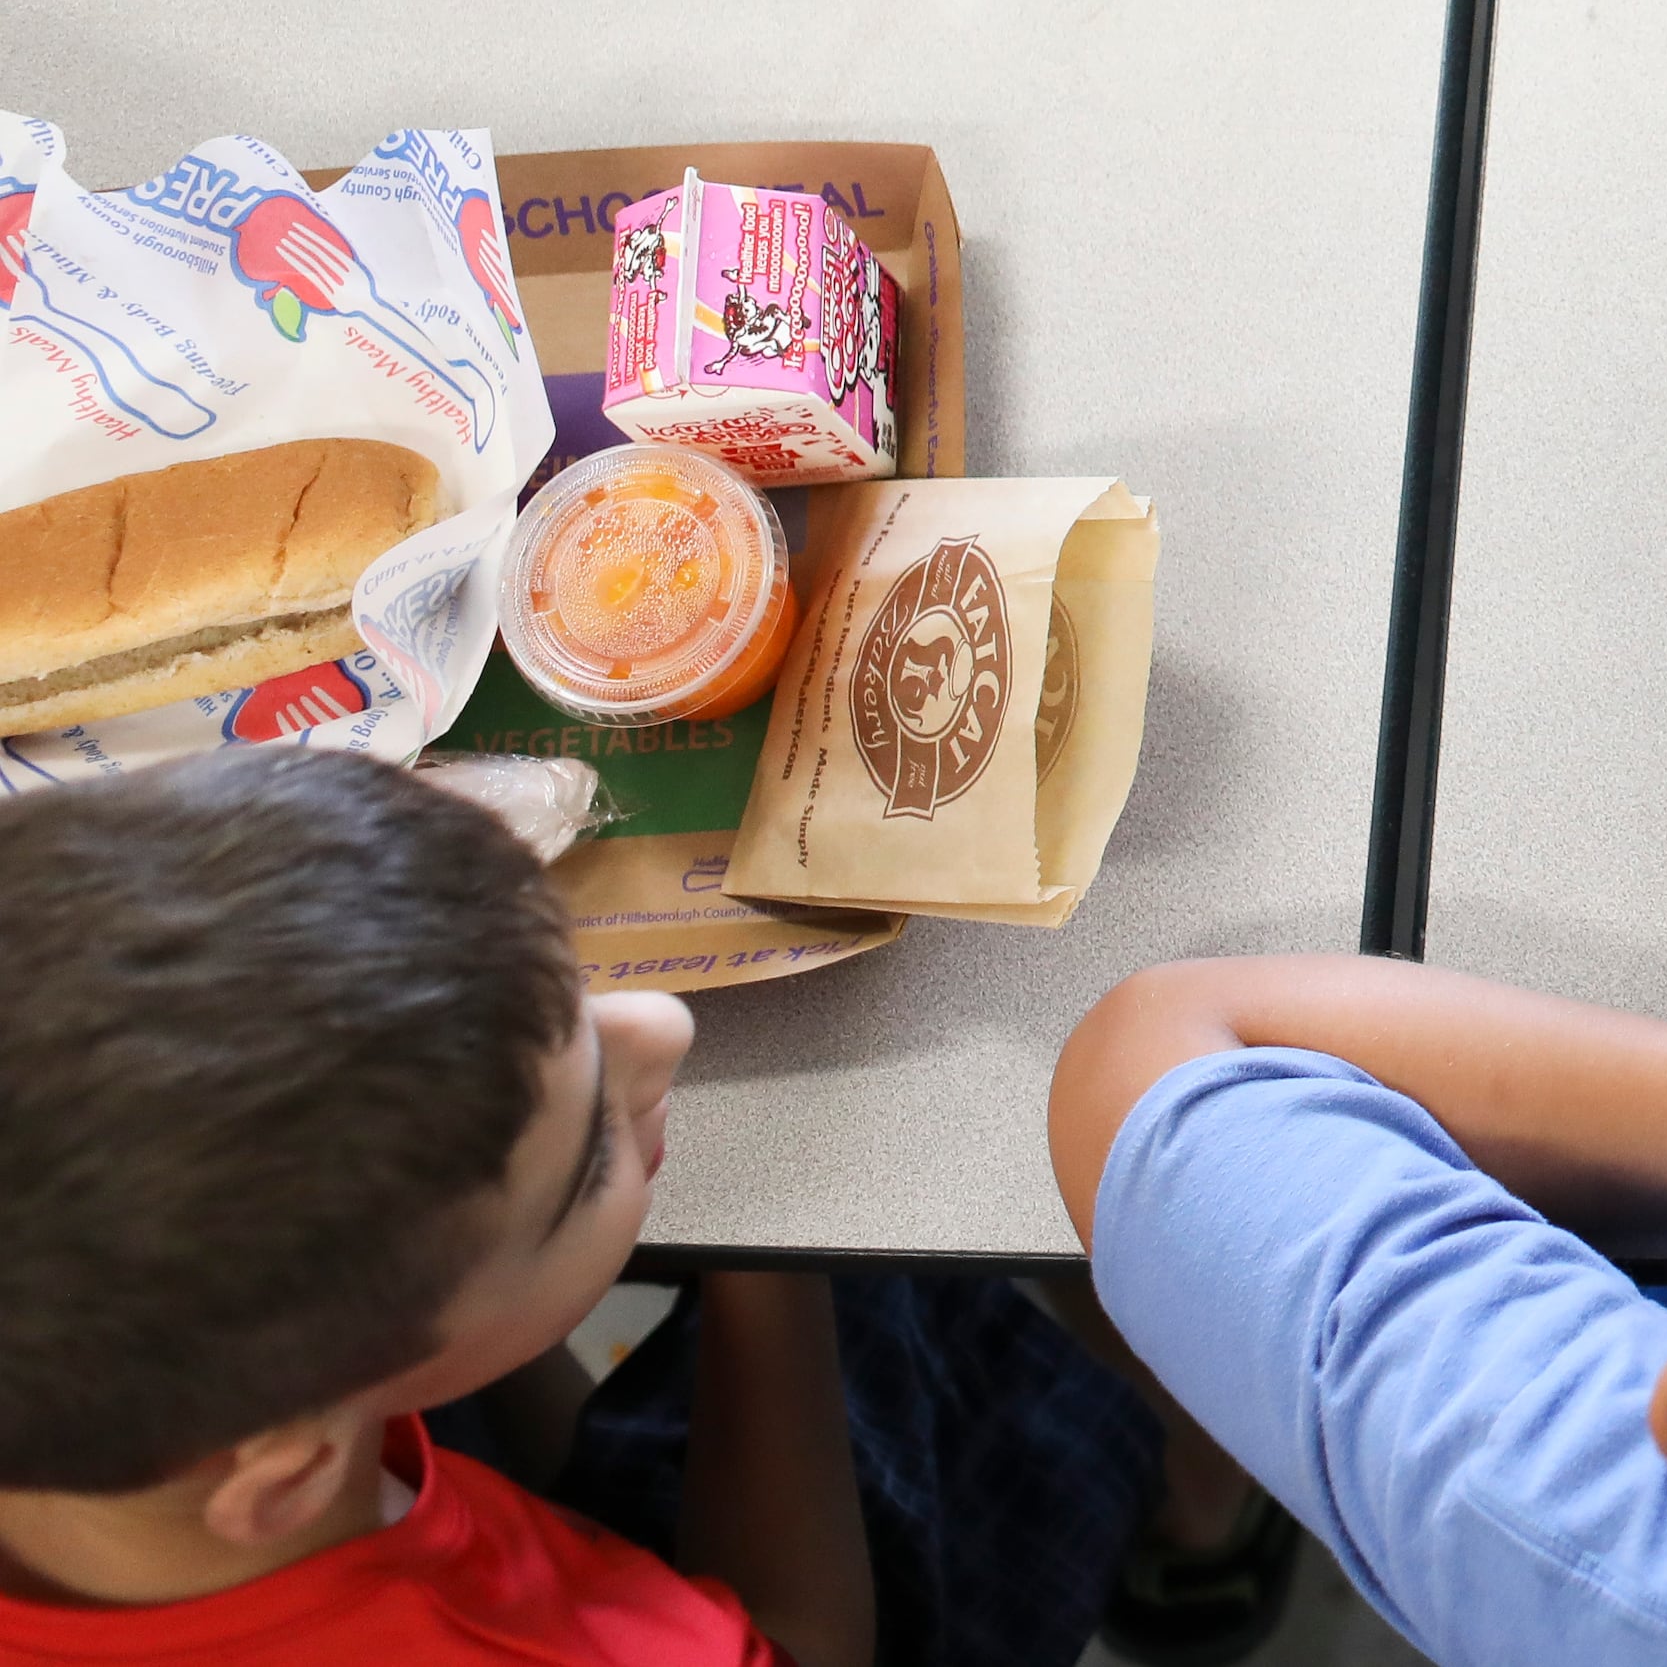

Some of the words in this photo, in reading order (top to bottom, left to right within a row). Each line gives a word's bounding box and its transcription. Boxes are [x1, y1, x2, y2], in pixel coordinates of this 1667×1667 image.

[76, 193, 130, 237] County
[743, 203, 757, 230] food
[757, 215, 770, 238] you
[132, 230, 219, 277] Hillsborough
[189, 235, 226, 256] Student
[739, 227, 756, 284] Healthier
[755, 239, 769, 276] keeps
[924, 220, 938, 310] Grains
[120, 301, 176, 340] Body
[416, 299, 461, 327] Body
[9, 326, 80, 374] Meals
[175, 337, 251, 398] Feeding
[344, 325, 410, 379] Meals
[67, 372, 143, 442] Healthy
[406, 371, 474, 446] Healthy
[860, 529, 888, 568] Food
[843, 578, 863, 622] Pure
[958, 573, 998, 664] FAT
[861, 589, 912, 751] Bakery
[476, 718, 737, 758] VEGETABLES
[948, 670, 1000, 776] CAT
[808, 745, 829, 800] Made
[797, 804, 815, 869] Simply
[605, 912, 619, 926] of
[620, 907, 701, 926] Hillsborough
[703, 903, 749, 922] County
[608, 954, 718, 981] least
